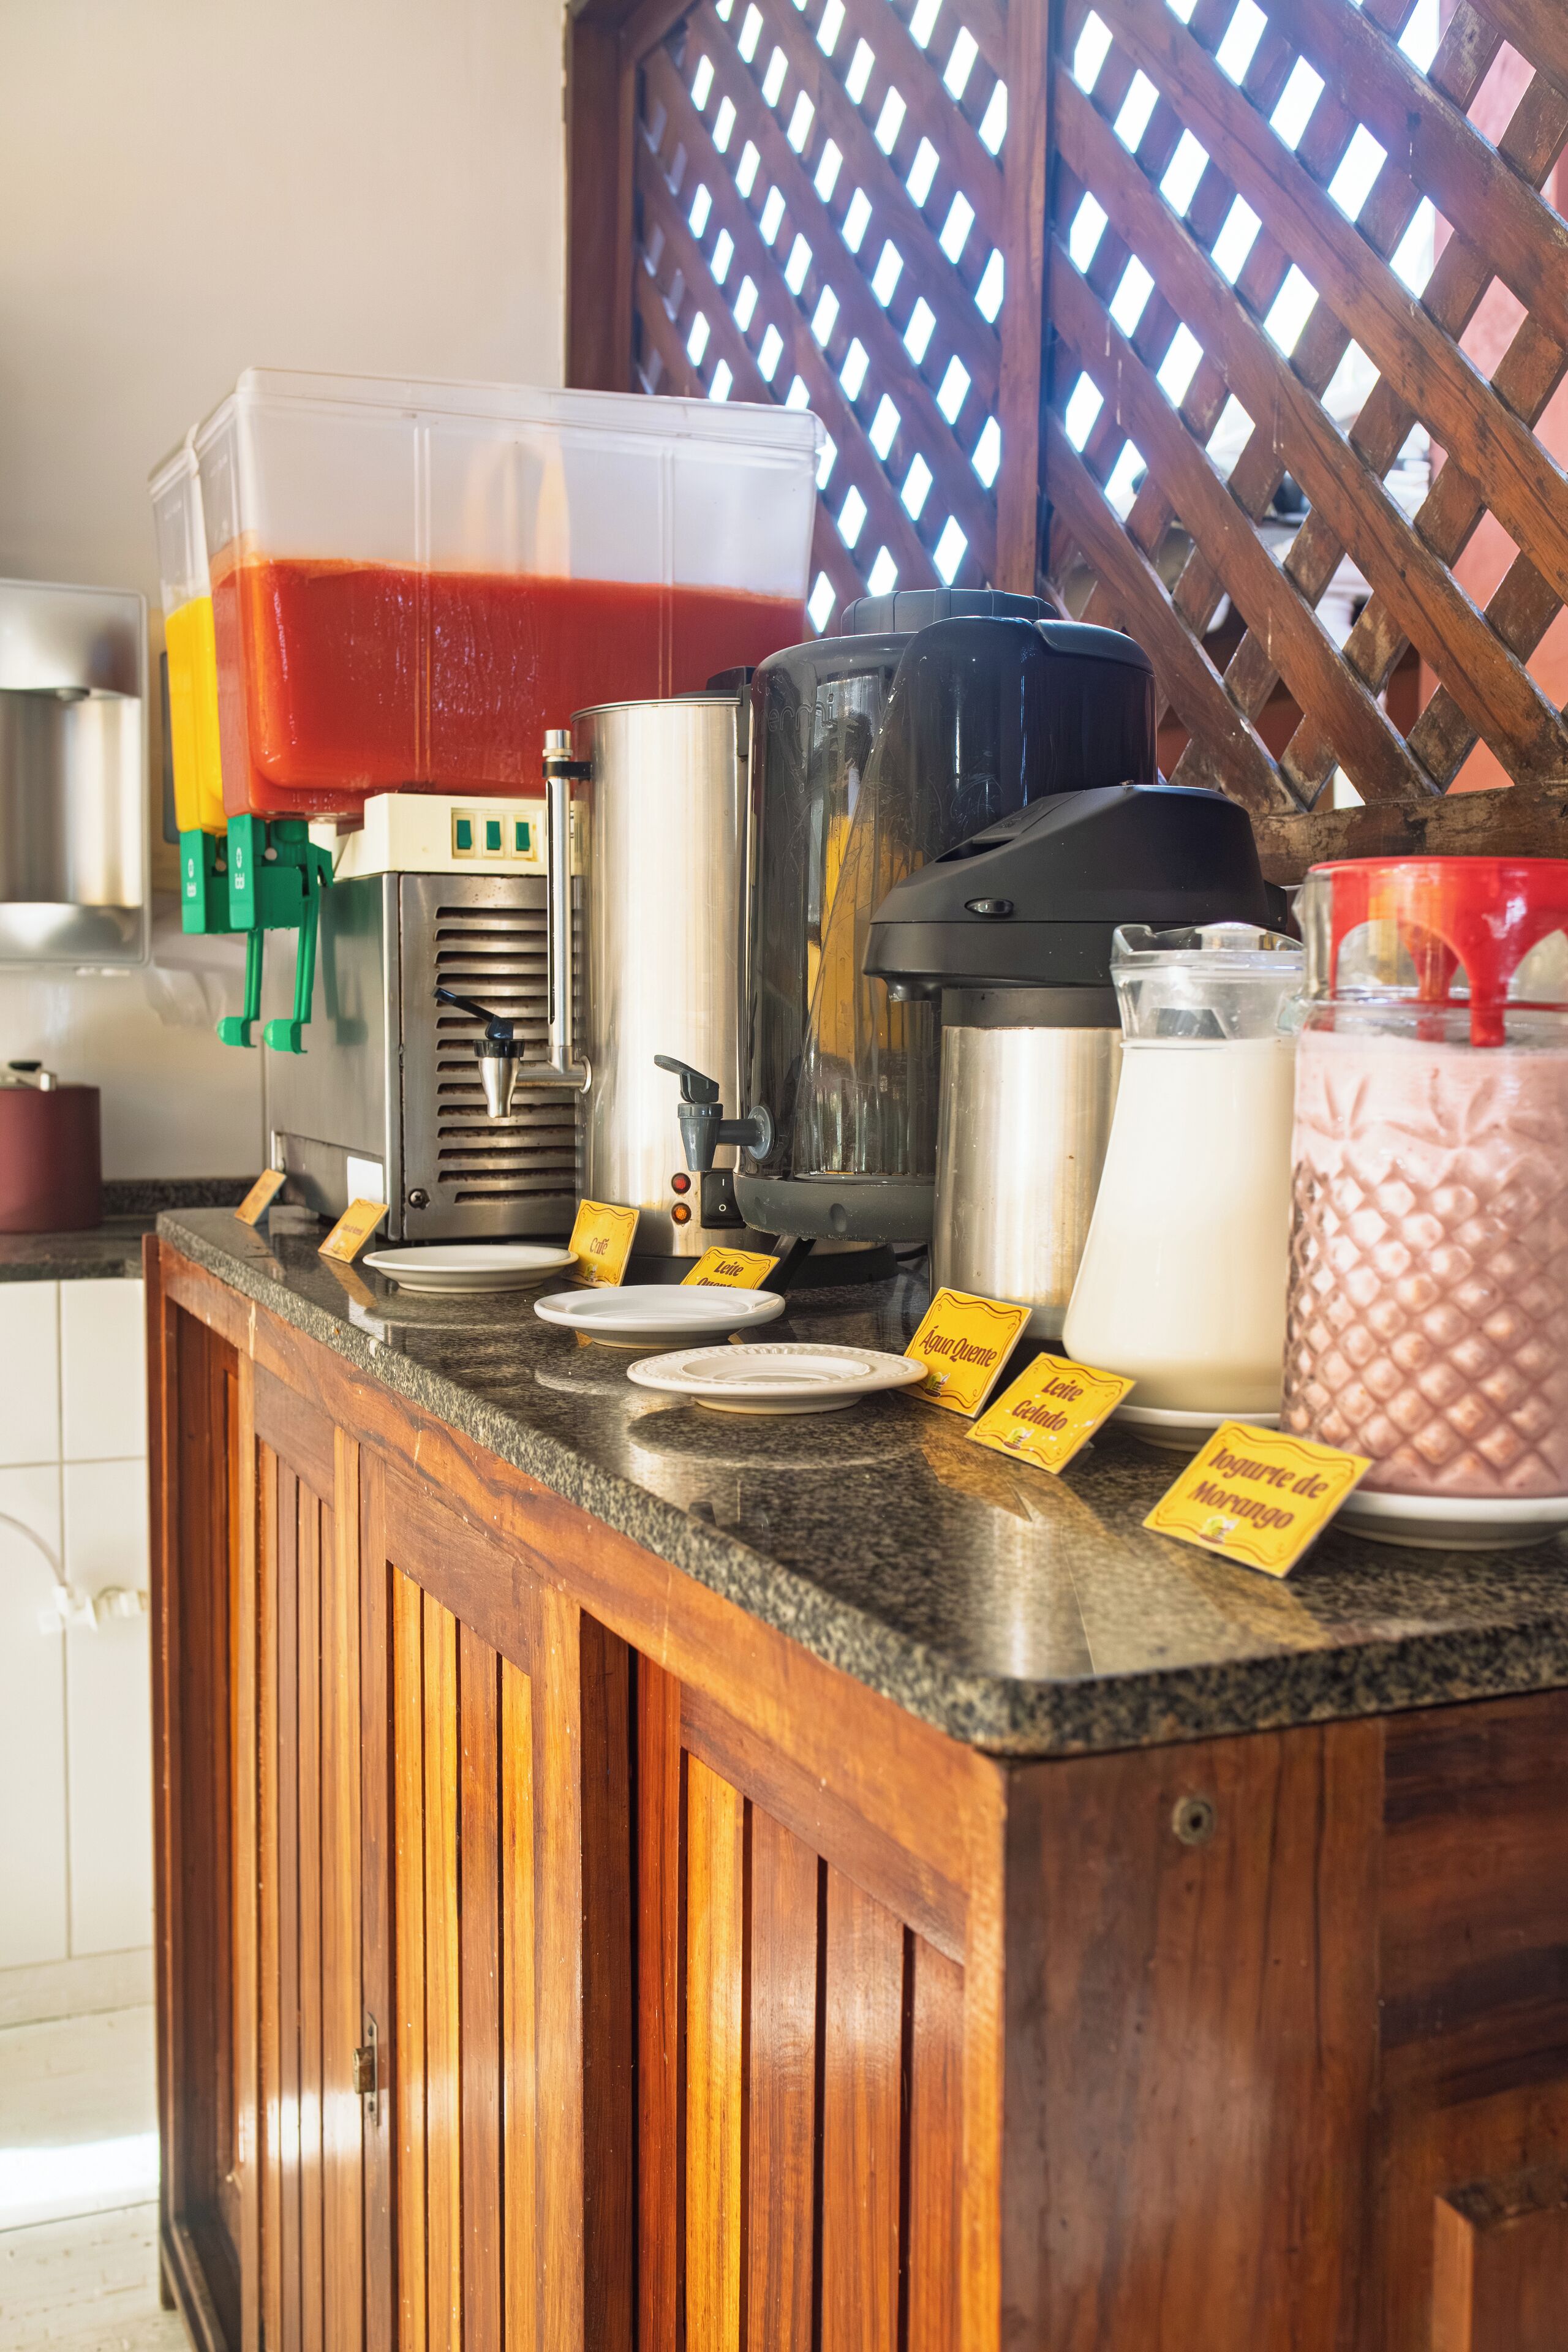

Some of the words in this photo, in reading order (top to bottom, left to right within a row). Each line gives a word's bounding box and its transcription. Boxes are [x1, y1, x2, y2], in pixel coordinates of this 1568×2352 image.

[590, 1237, 609, 1256] Café
[713, 1260, 744, 1277] Leite
[919, 1325, 955, 1355] Água
[949, 1338, 998, 1367] Quente
[1041, 1376, 1084, 1402] Leite
[1011, 1400, 1068, 1431] Gelado
[1208, 1447, 1296, 1488] Iogurte
[1291, 1473, 1329, 1499] de
[1186, 1480, 1295, 1529] Morango
